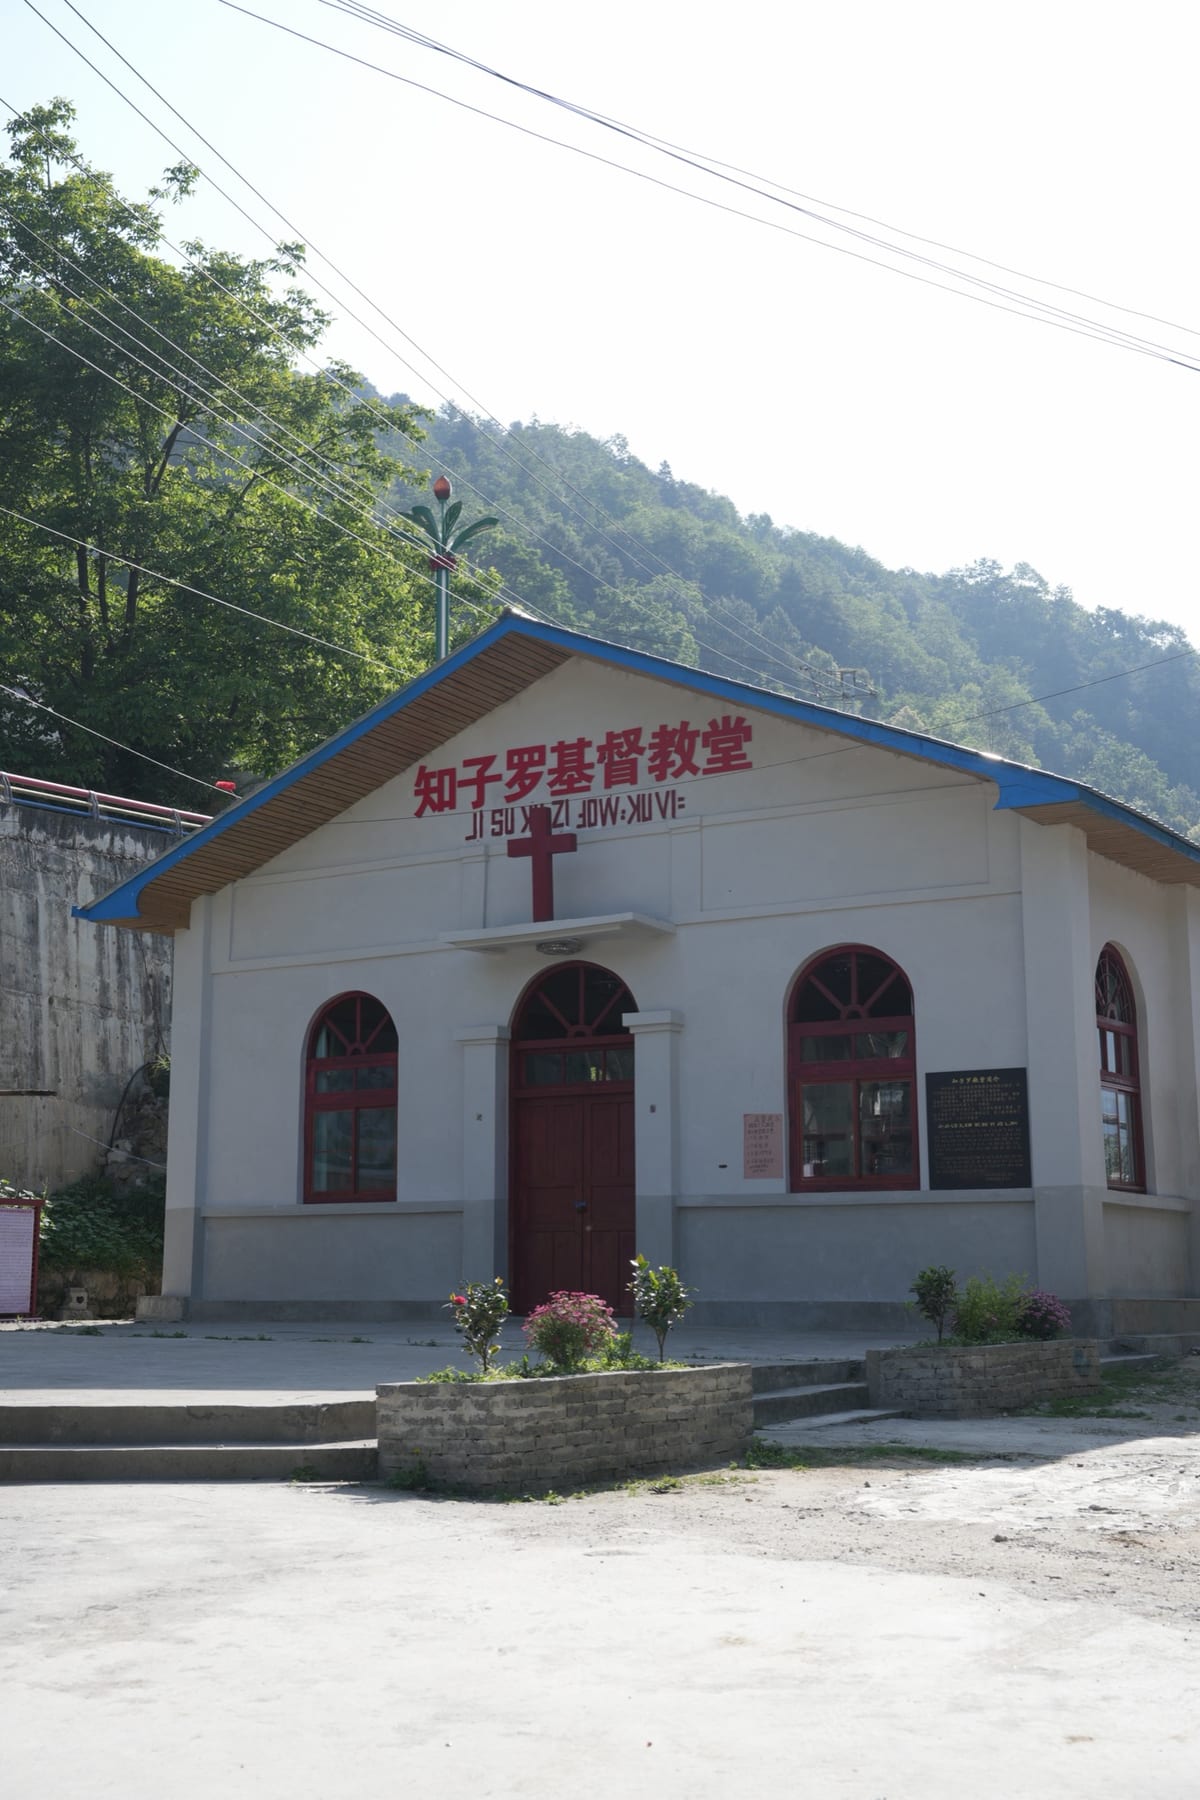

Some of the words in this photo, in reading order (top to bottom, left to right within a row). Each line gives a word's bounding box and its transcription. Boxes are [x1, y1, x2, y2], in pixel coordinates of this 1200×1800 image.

[414, 715, 753, 818] 知子罗基督教堂
